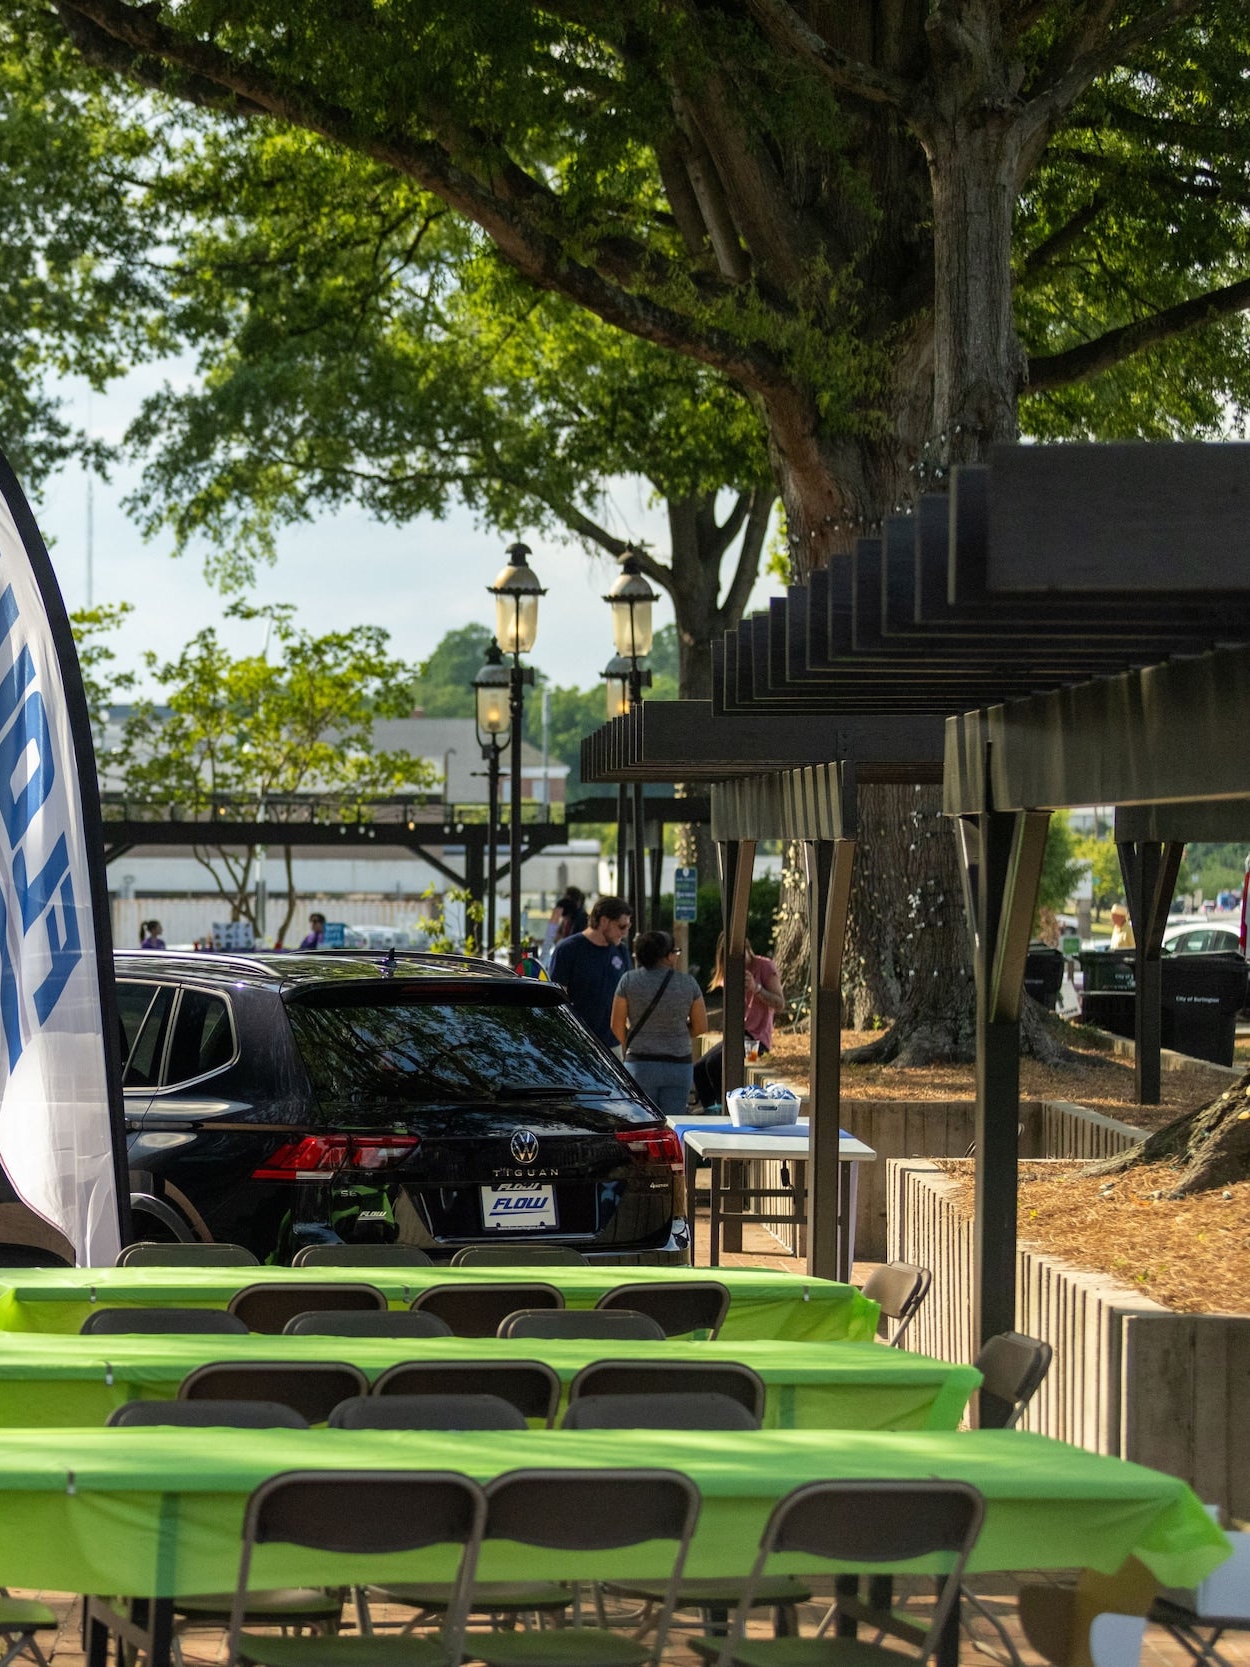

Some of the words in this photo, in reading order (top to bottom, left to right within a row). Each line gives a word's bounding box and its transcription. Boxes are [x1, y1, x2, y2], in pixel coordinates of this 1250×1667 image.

[493, 1168, 559, 1177] TIGUAN
[497, 1182, 540, 1191] FLOW
[492, 1197, 549, 1210] FLOW
